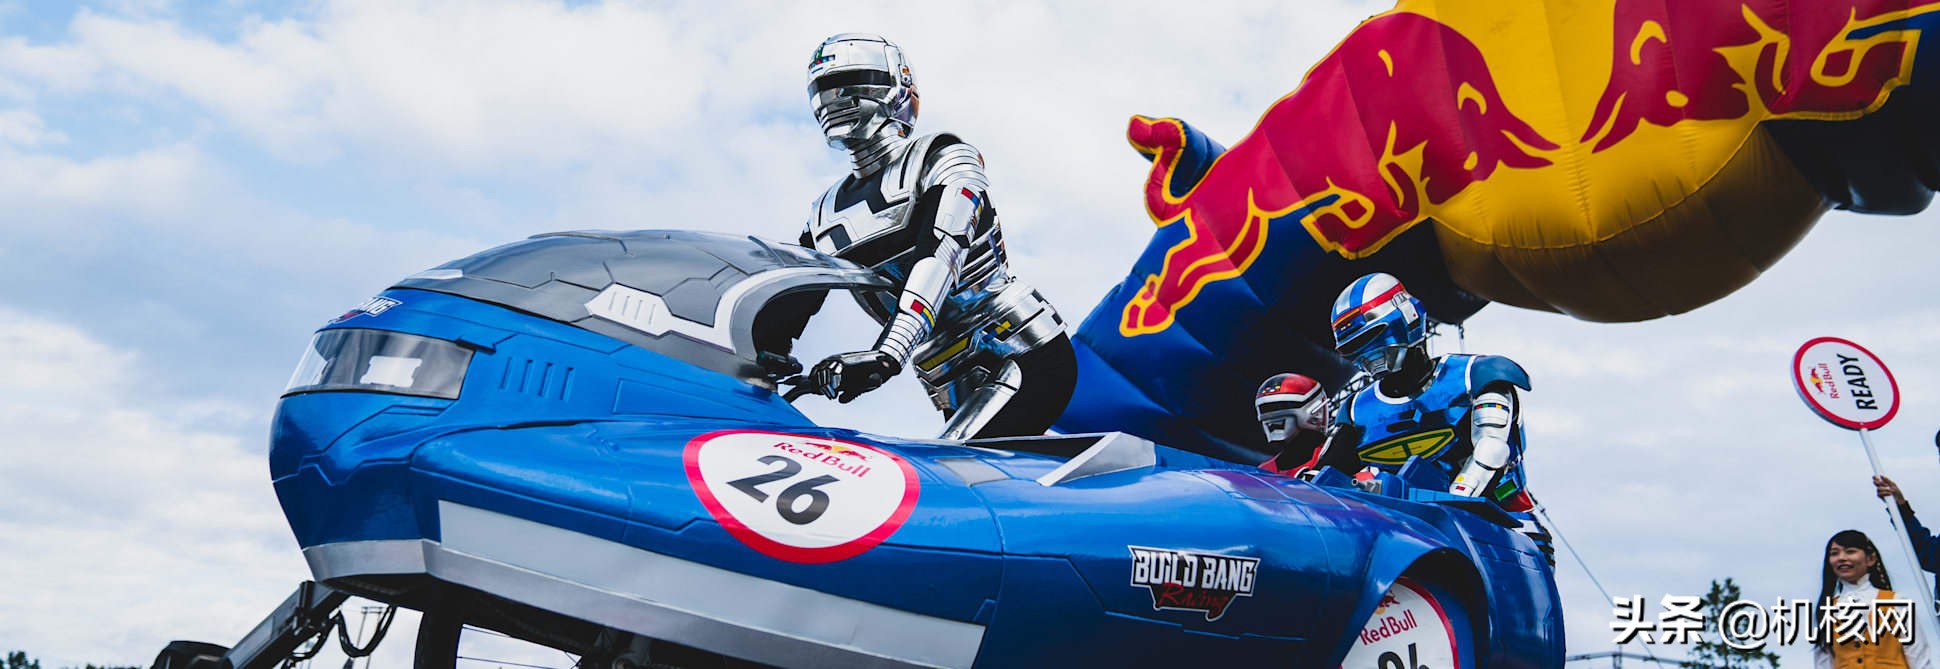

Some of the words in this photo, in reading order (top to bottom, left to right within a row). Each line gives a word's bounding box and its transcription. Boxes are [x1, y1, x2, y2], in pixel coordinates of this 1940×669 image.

[1836, 353, 1878, 410] READY
[773, 442, 821, 461] Red
[821, 452, 871, 478] Bull
[726, 454, 840, 525] 26
[1133, 550, 1199, 588] BUILD
[1201, 556, 1255, 592] BANG
[1157, 581, 1230, 618] Racing
[1360, 617, 1391, 645] Red
[1386, 608, 1418, 635] Bull
